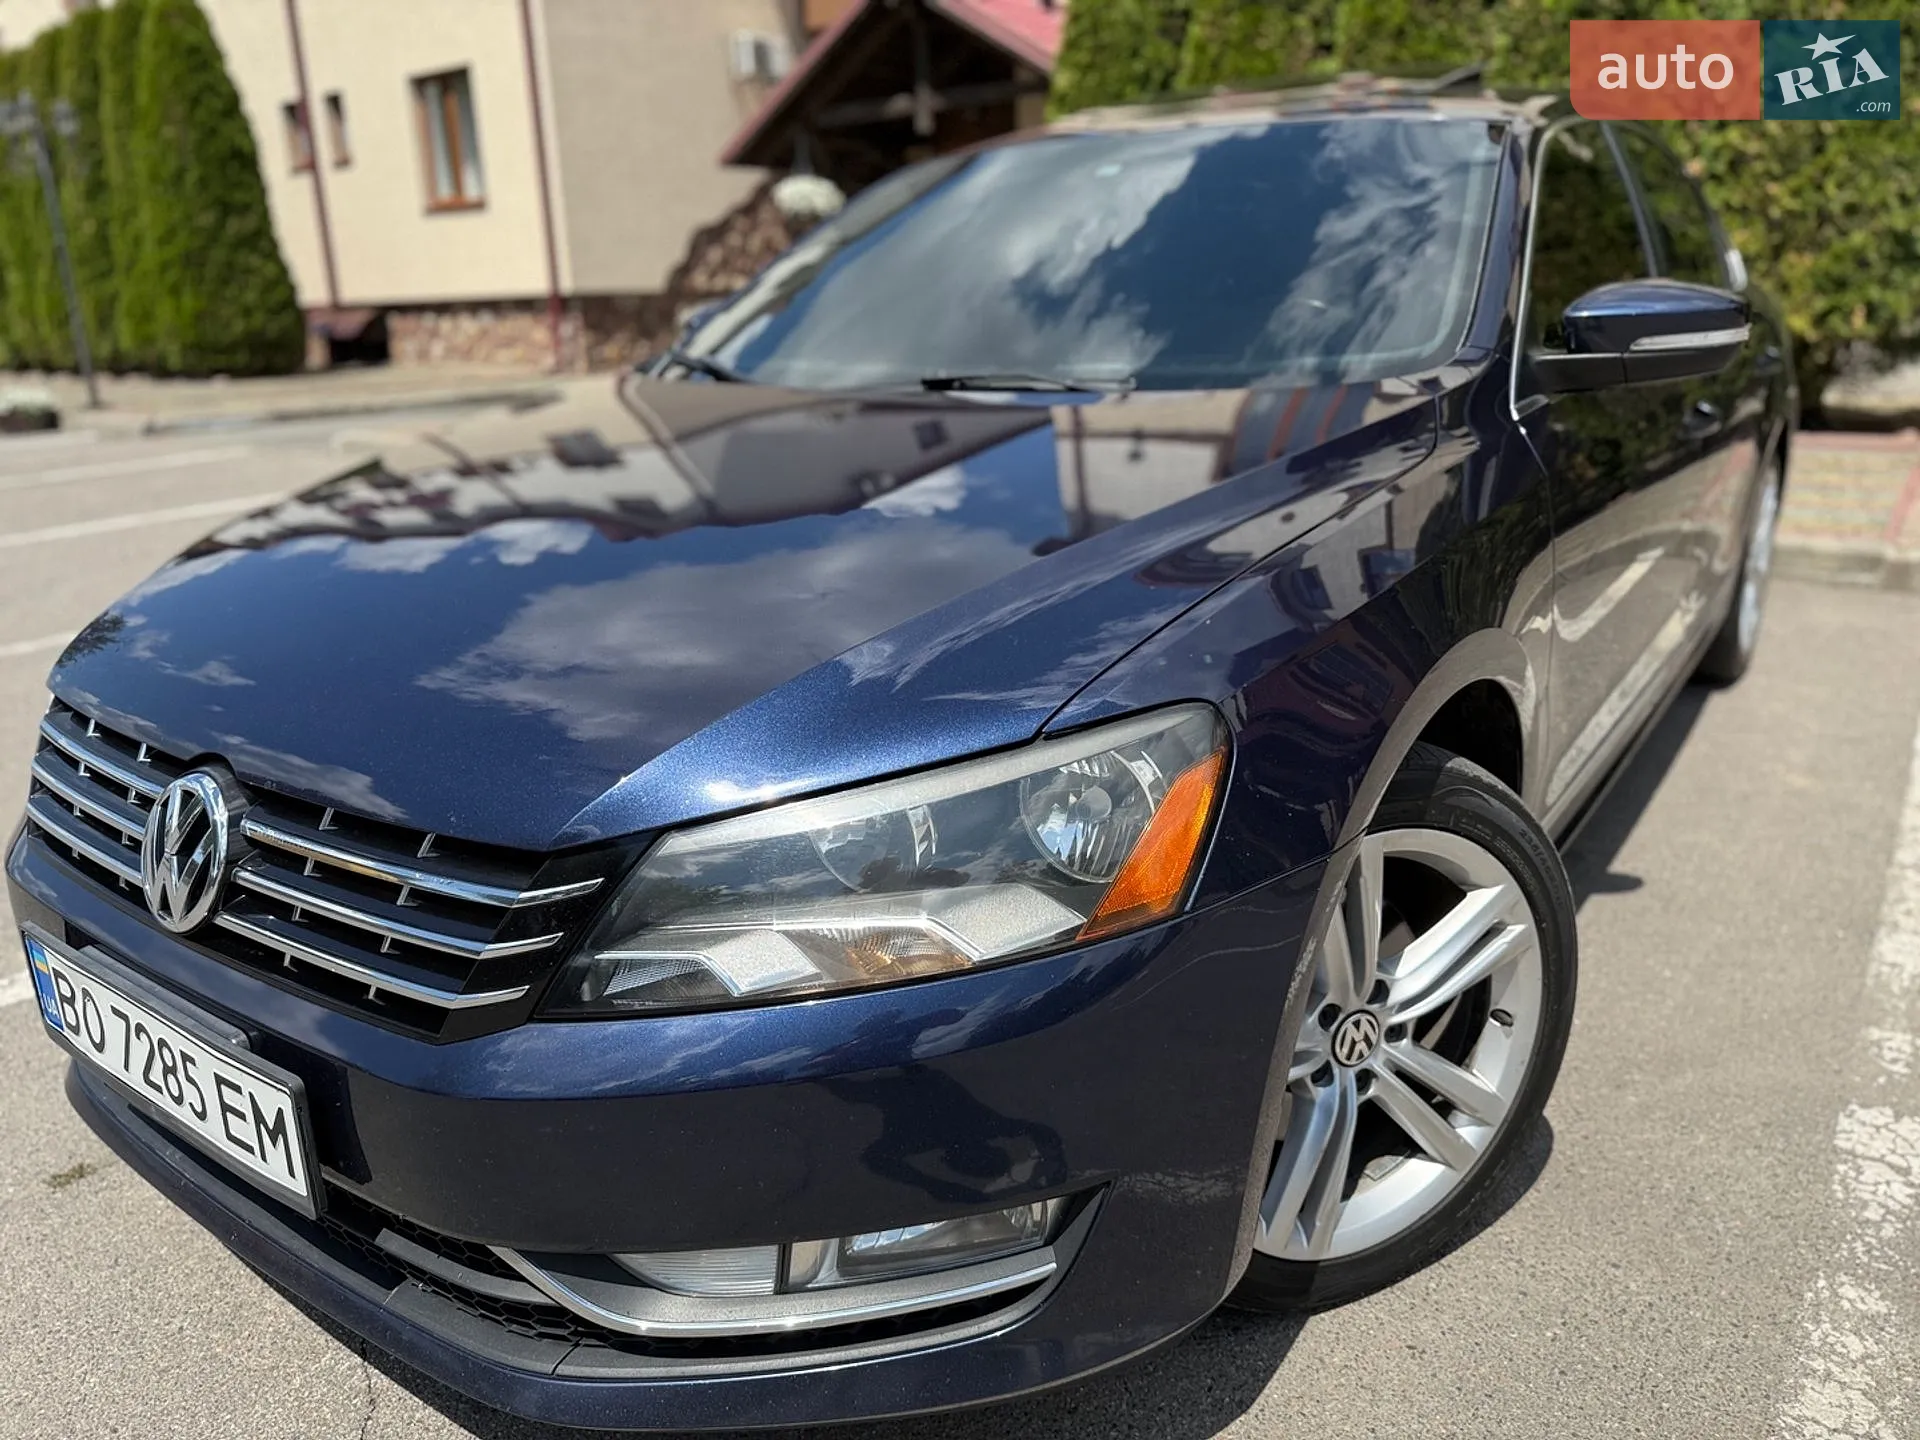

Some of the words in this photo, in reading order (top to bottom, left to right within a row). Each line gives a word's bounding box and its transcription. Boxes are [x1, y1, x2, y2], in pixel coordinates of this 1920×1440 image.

[42, 993, 60, 1019] UA
[52, 966, 106, 1054] BO
[110, 1005, 208, 1122] 7285
[213, 1072, 296, 1180] EM
